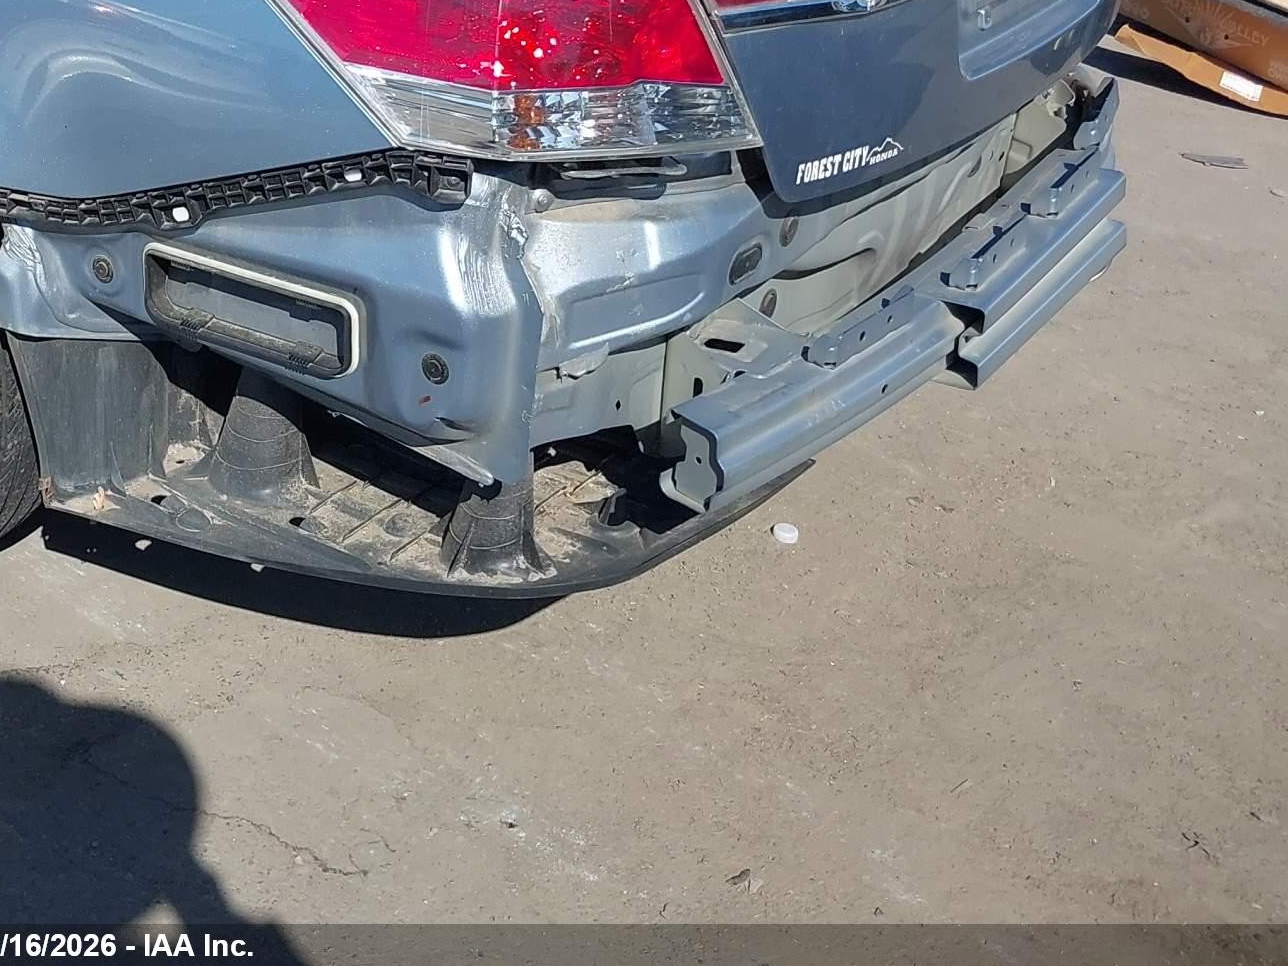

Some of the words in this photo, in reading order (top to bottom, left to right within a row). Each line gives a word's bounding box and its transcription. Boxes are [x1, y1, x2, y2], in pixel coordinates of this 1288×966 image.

[795, 153, 842, 185] FOREST
[842, 145, 870, 173] CITY
[869, 147, 899, 165] HONDA
